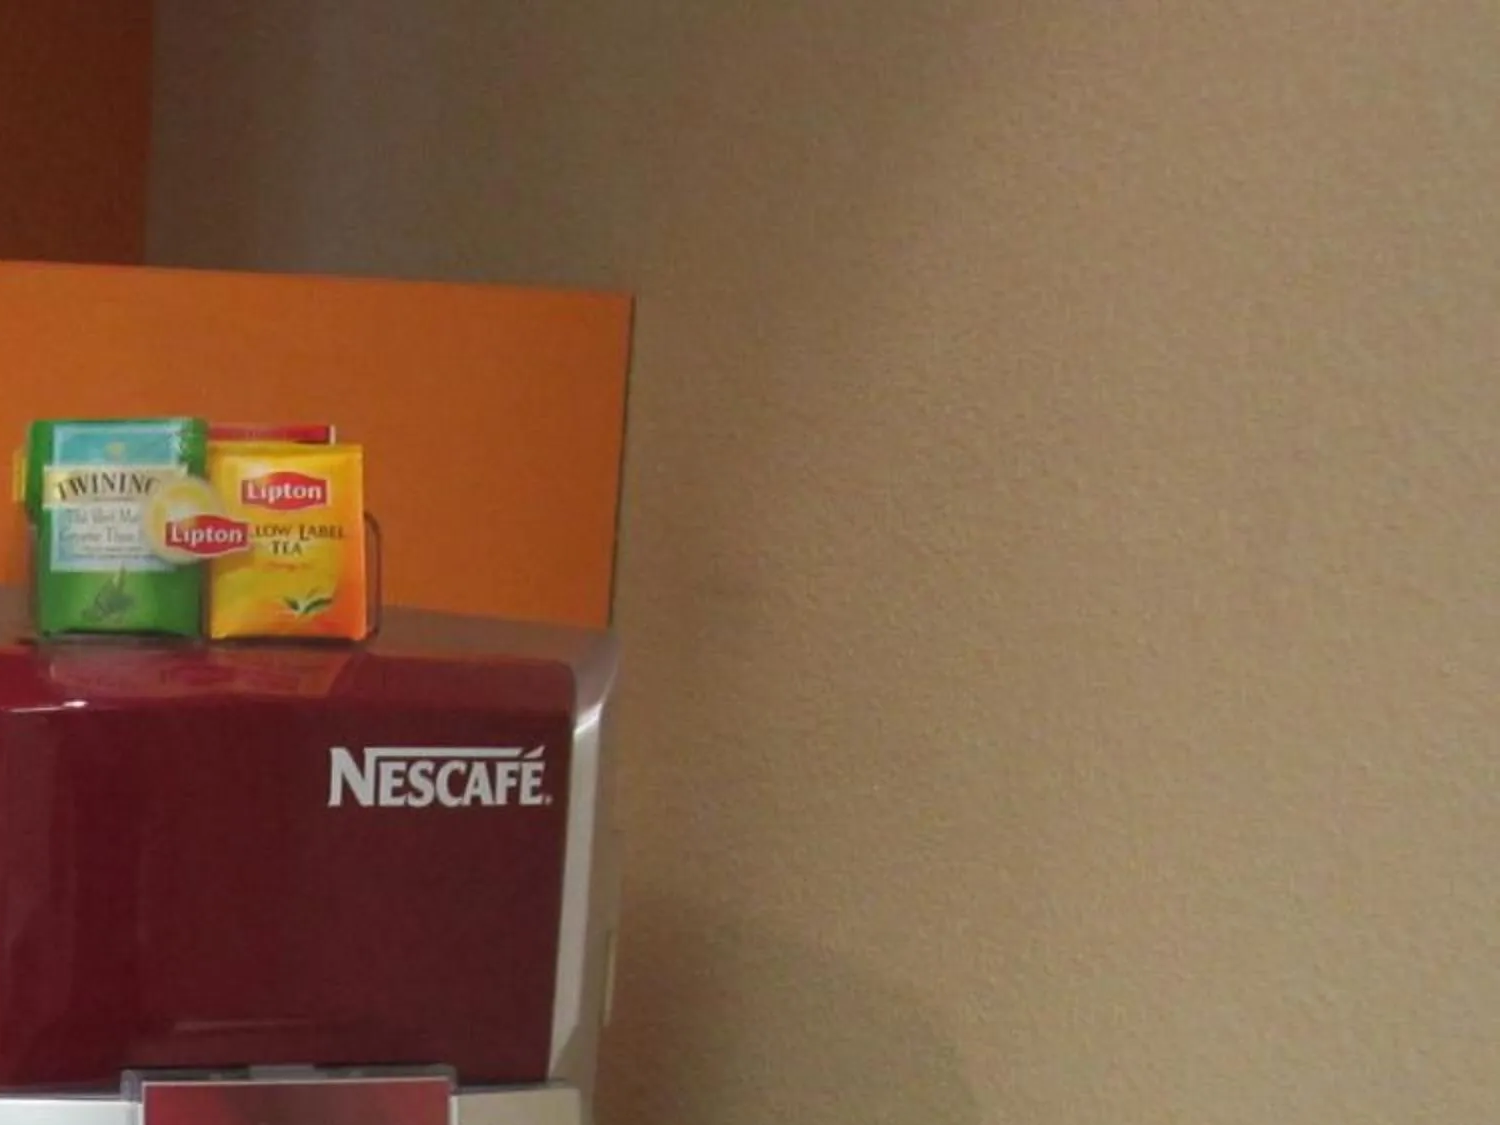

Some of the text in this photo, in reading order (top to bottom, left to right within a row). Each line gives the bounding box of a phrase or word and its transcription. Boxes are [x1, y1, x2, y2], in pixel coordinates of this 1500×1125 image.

[246, 481, 322, 504] Lipton
[170, 522, 243, 547] Lipton
[299, 522, 346, 541] LABEL
[271, 540, 304, 557] TEA
[327, 745, 547, 808] NESCAFÉ
